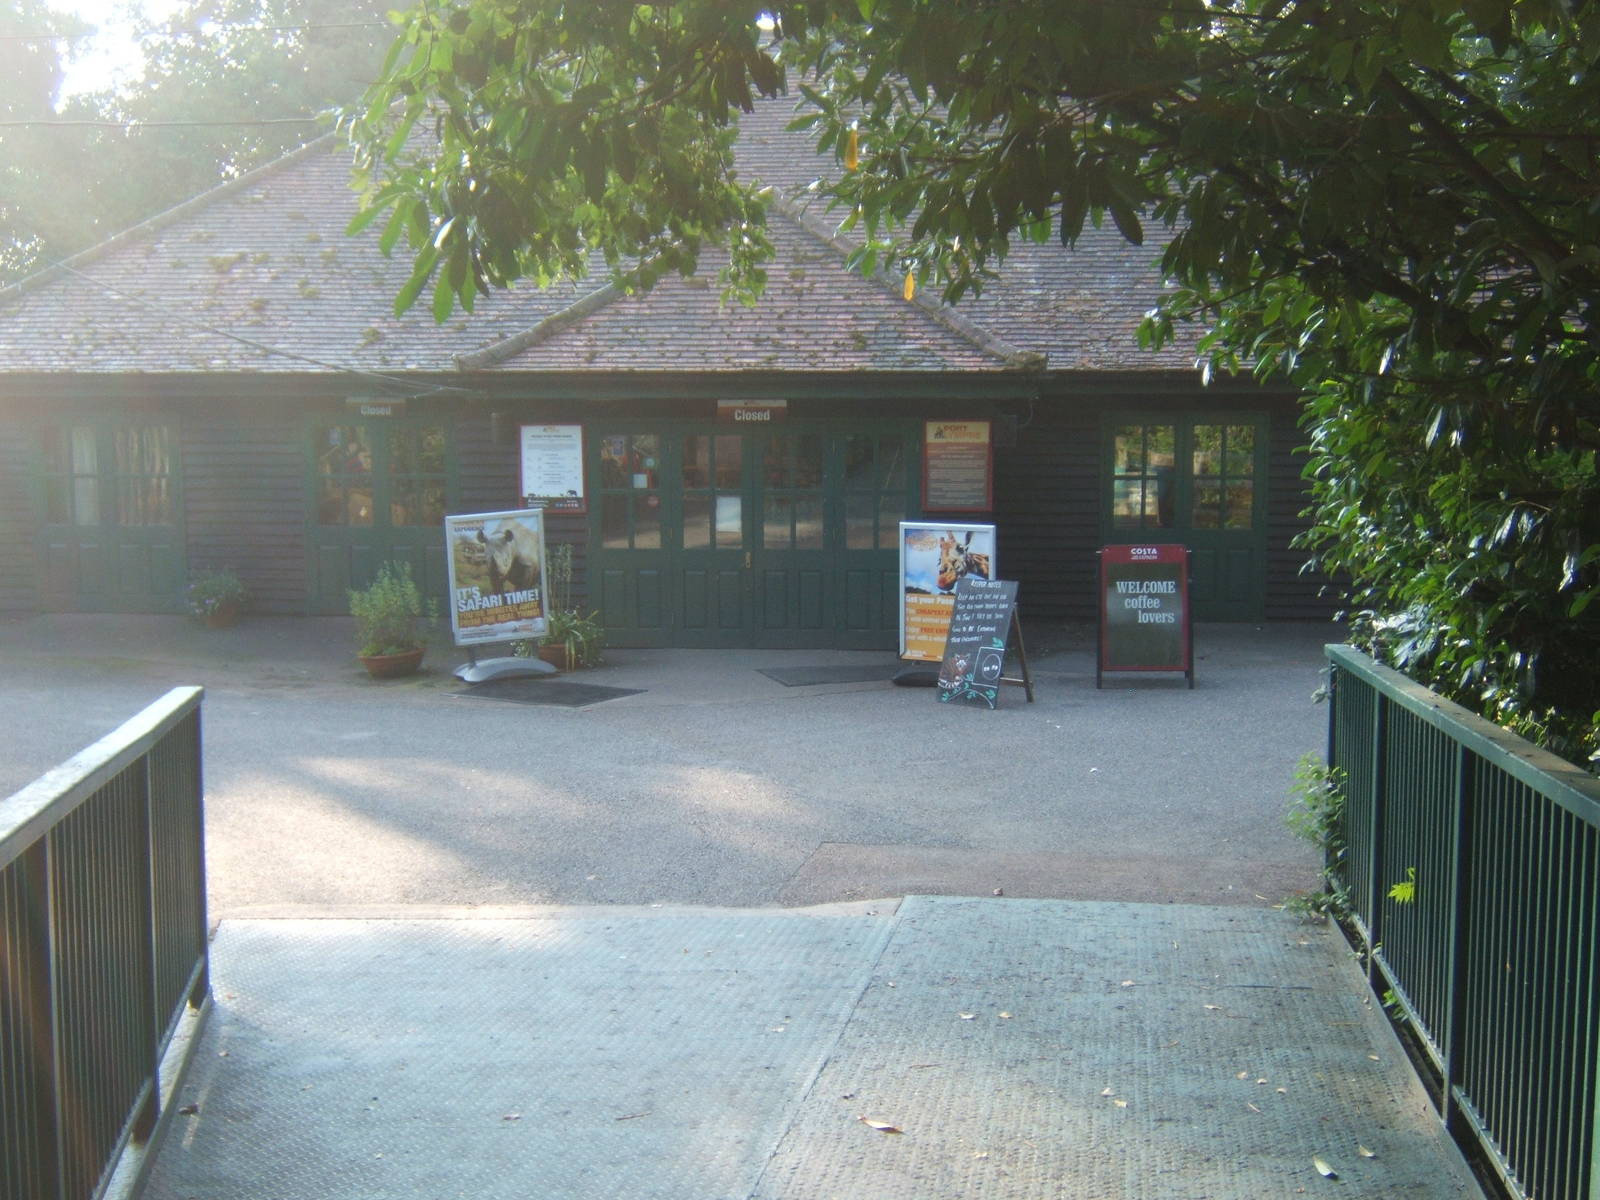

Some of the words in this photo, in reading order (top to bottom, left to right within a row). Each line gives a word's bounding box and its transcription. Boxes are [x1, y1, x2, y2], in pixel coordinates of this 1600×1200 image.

[360, 405, 392, 416] Closed
[734, 408, 771, 421] Closed
[456, 586, 481, 599] IT'S
[1116, 581, 1176, 593] WELCOME
[458, 593, 503, 612] SAFARI
[504, 589, 539, 604] TIME!
[1124, 595, 1161, 609] coffee
[1138, 610, 1175, 624] lovers
